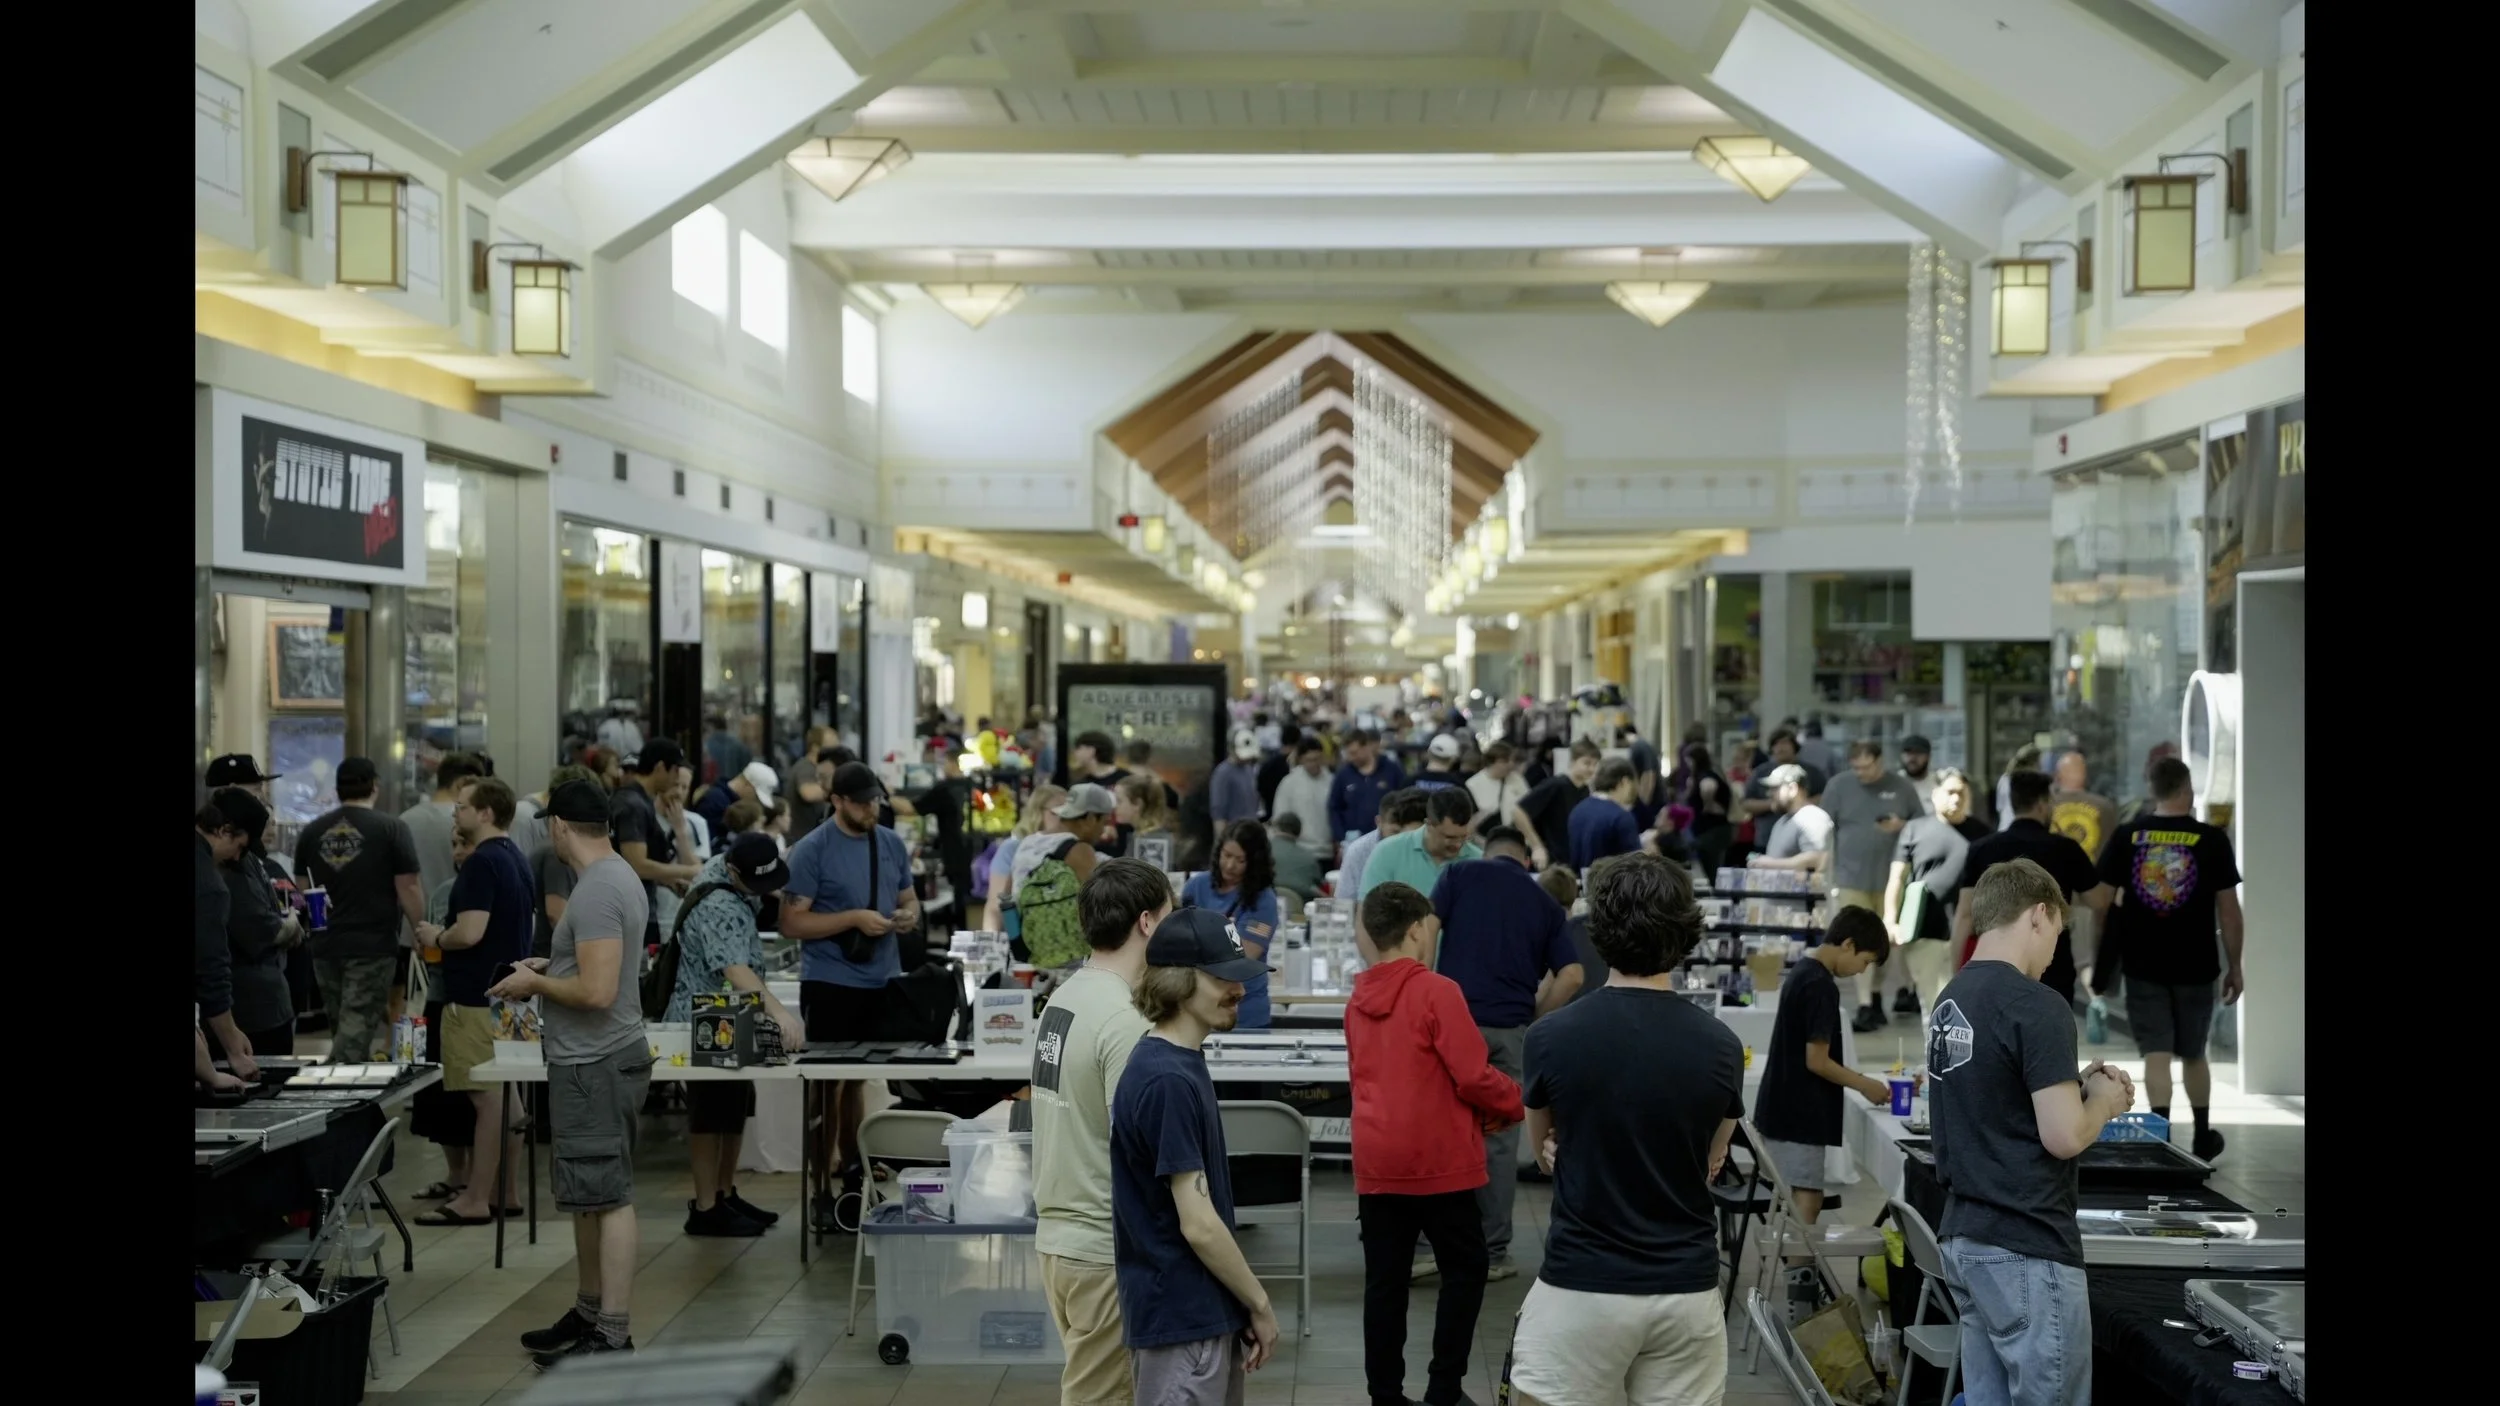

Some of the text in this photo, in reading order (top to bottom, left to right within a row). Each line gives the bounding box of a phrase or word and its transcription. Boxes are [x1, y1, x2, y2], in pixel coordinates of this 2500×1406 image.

[1083, 690, 1197, 705] ADVERTISE
[1105, 711, 1175, 726] HERE
[1950, 1028, 1970, 1040] CREW
